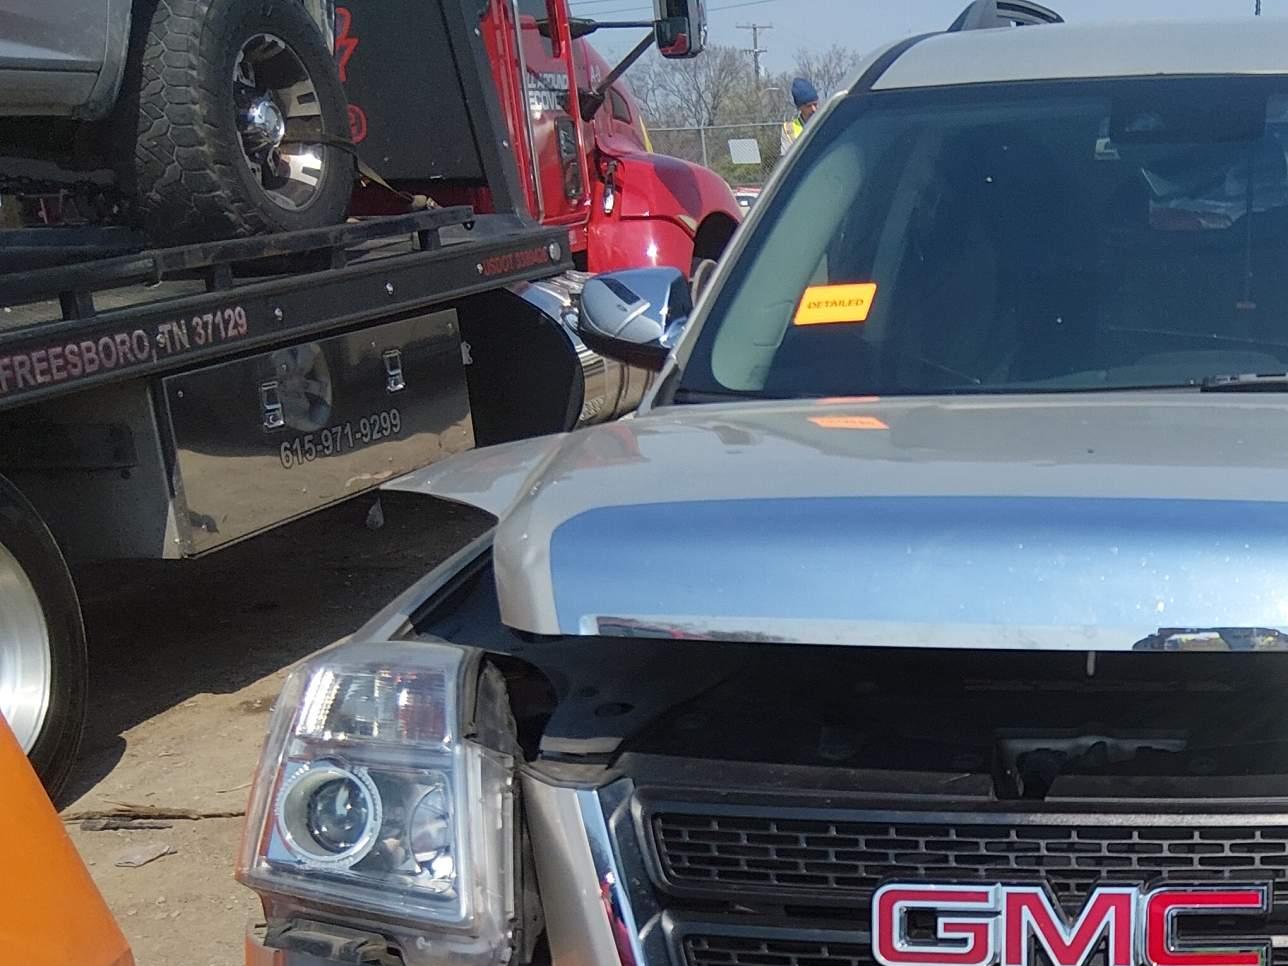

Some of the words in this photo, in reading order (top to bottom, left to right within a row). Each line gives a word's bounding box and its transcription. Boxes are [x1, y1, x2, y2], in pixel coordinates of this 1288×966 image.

[806, 299, 864, 310] DETAILED
[158, 319, 191, 353] TN
[192, 306, 248, 345] 37129
[280, 408, 400, 470] 615-971-9299
